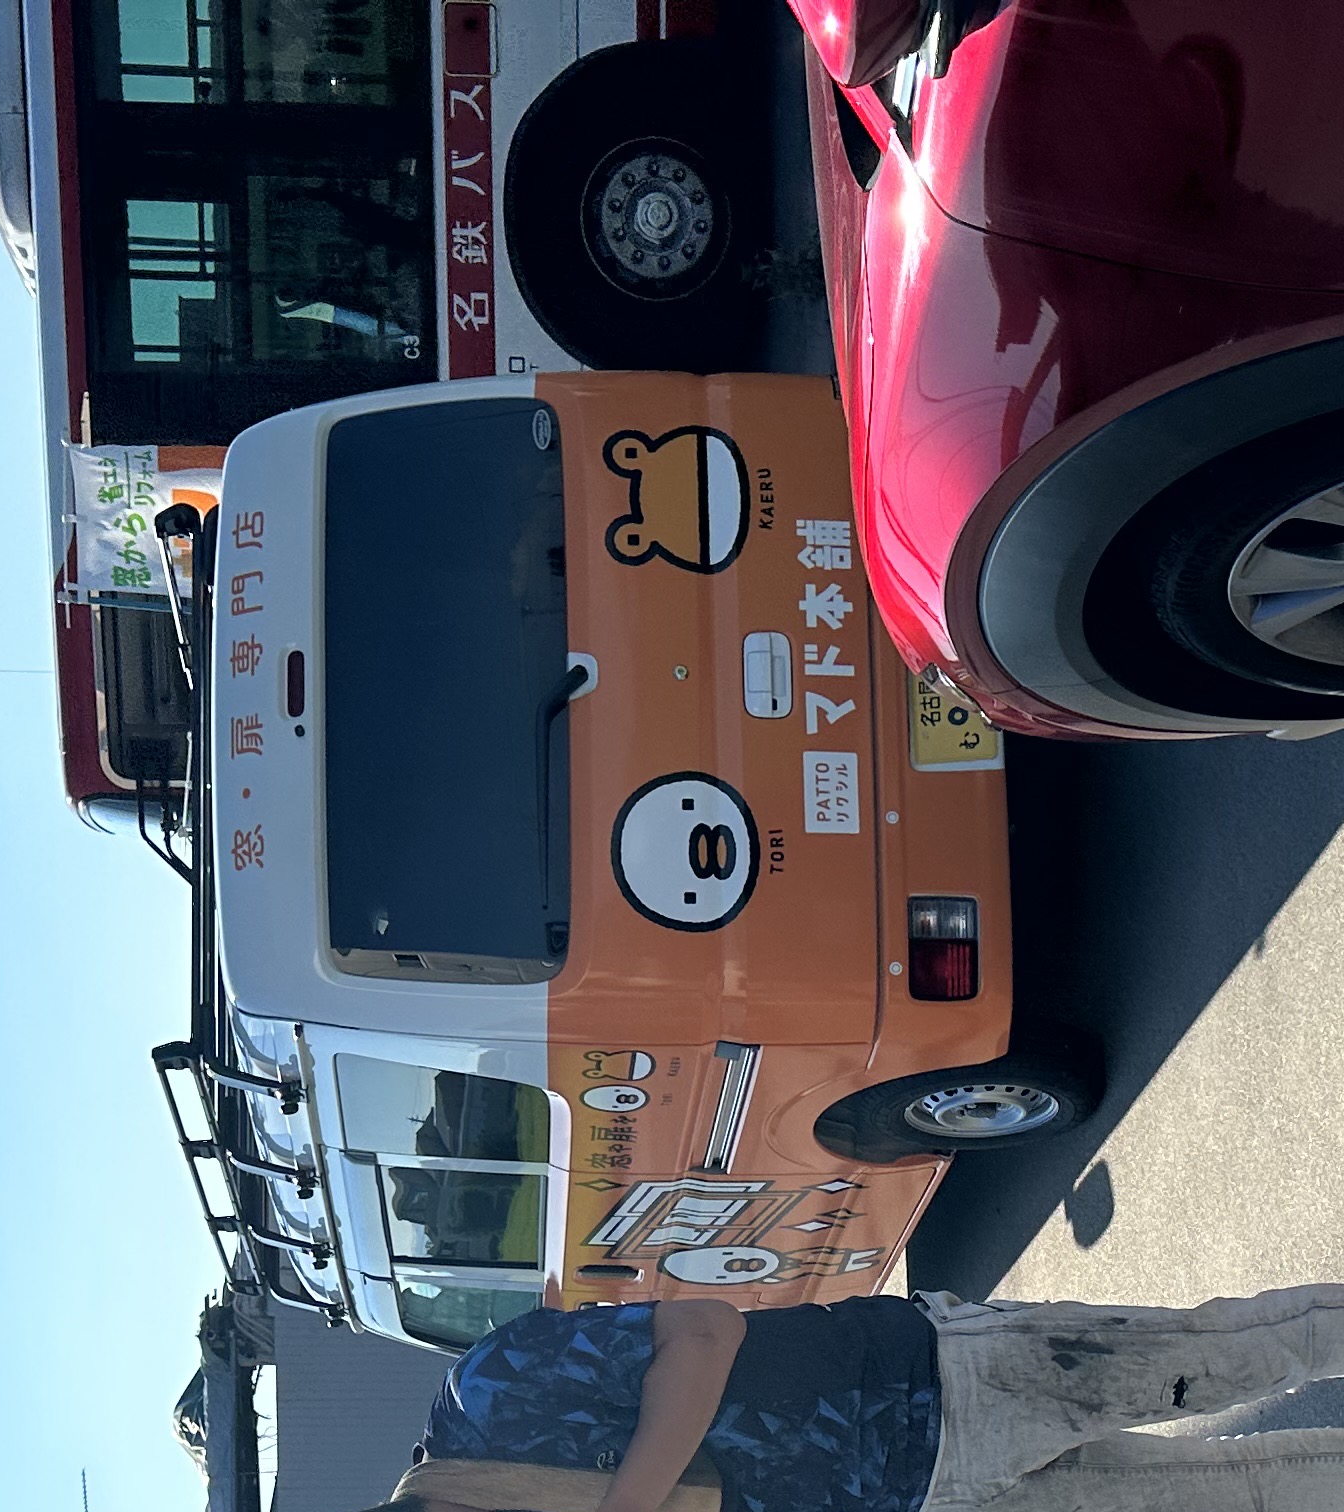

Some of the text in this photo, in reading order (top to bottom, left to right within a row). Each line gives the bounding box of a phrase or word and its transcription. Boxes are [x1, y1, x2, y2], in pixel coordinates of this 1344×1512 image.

[449, 84, 490, 332] 名鉄バス
[403, 335, 421, 360] C3
[133, 450, 156, 506] リフォーム
[758, 467, 775, 531] KAERU
[110, 512, 152, 588] 窓から
[795, 518, 856, 735] マド本舗
[958, 731, 980, 750] む
[815, 762, 831, 823] PATTO
[834, 763, 850, 823] リクシル
[768, 828, 785, 875] TORI
